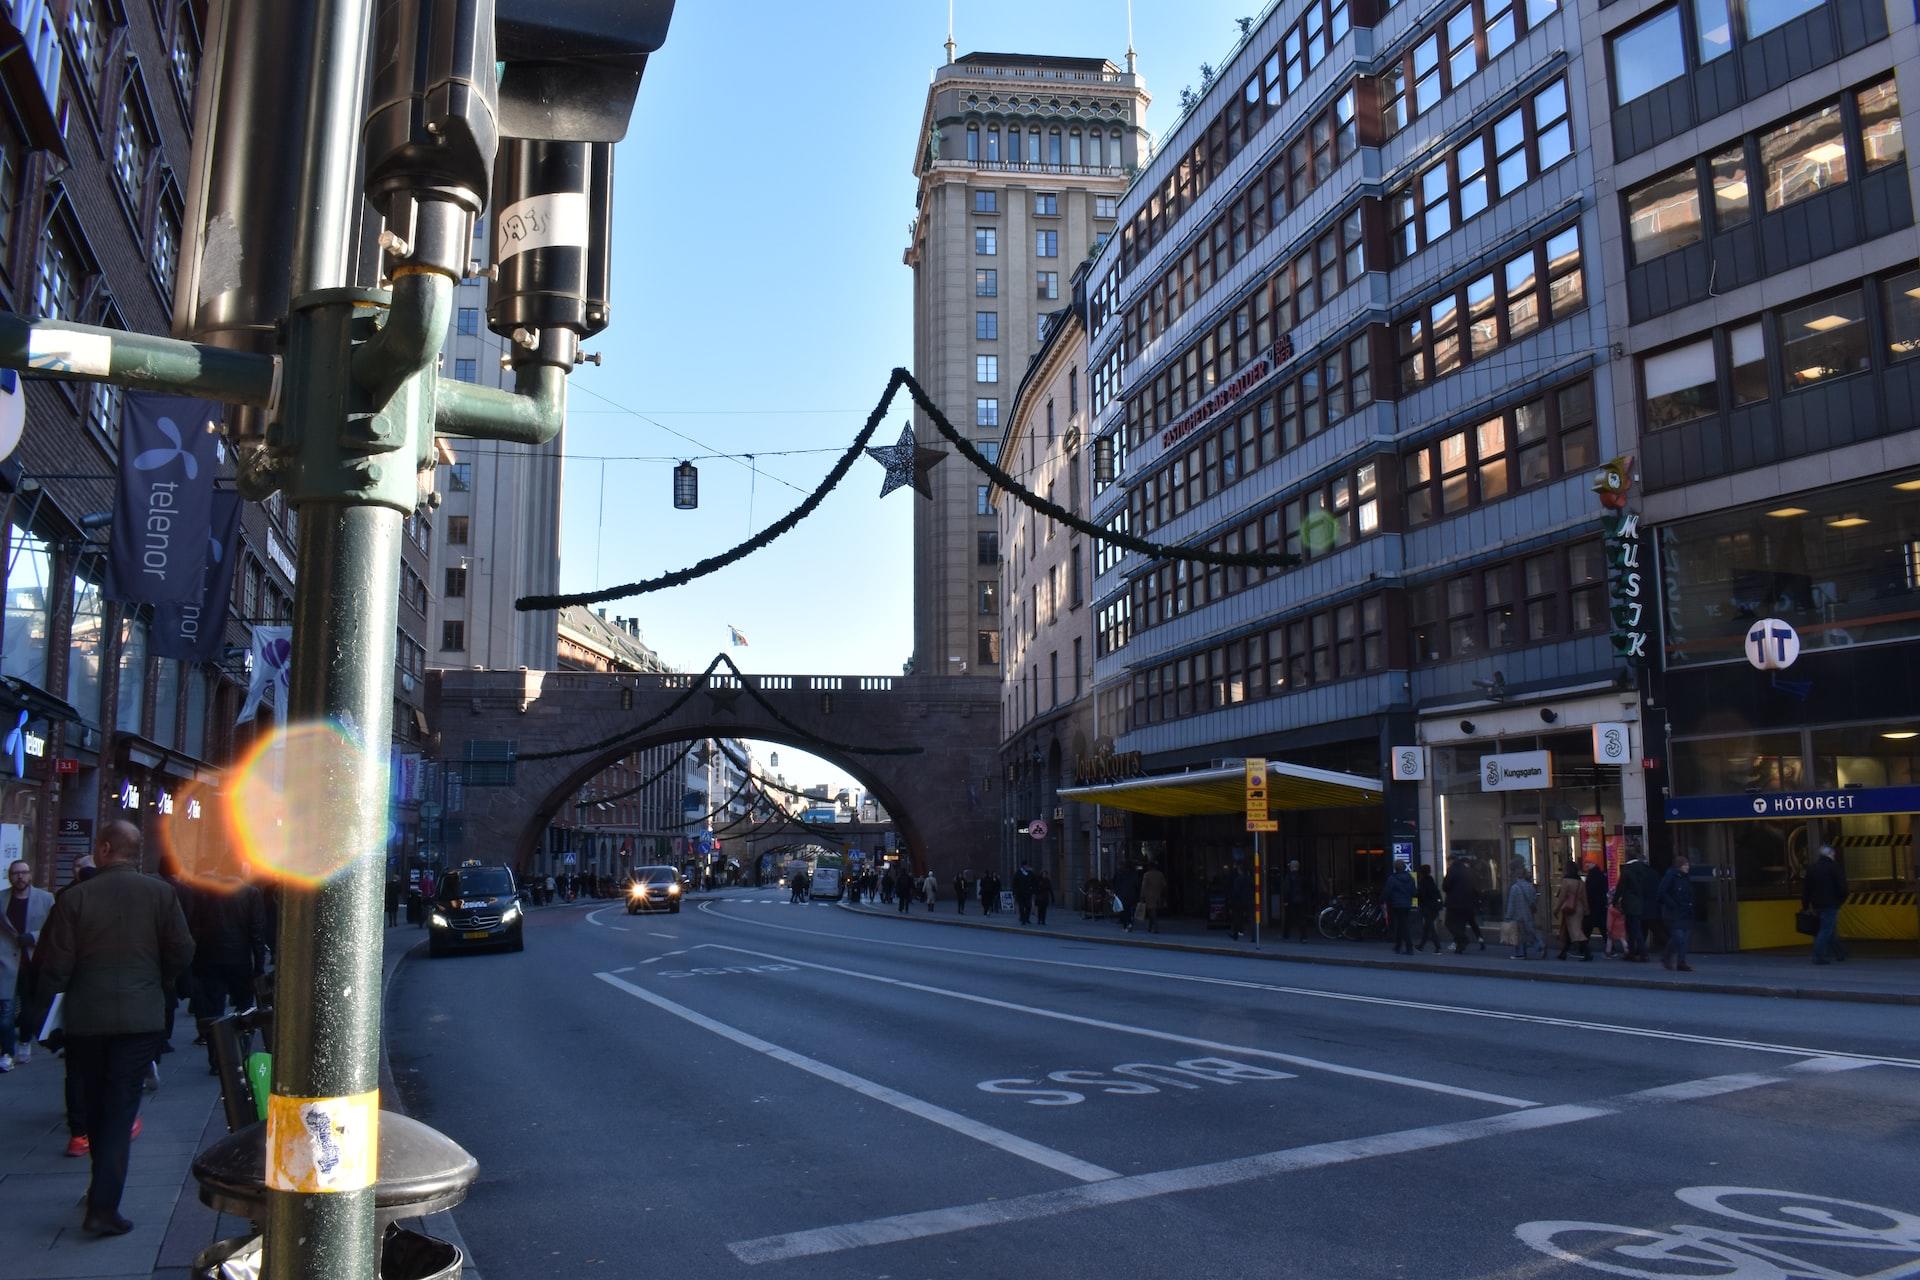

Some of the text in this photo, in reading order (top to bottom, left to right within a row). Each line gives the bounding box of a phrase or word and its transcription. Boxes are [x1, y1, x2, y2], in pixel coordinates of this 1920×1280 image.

[1163, 361, 1266, 448] FASTIGHETS AB BALDER
[143, 481, 179, 580] telenor
[1618, 515, 1648, 658] MUSIK
[1503, 767, 1542, 779] Kungsgatan
[66, 820, 80, 831] 36
[1774, 795, 1855, 811] HÖTORGET
[976, 1056, 1299, 1106] BUSS
